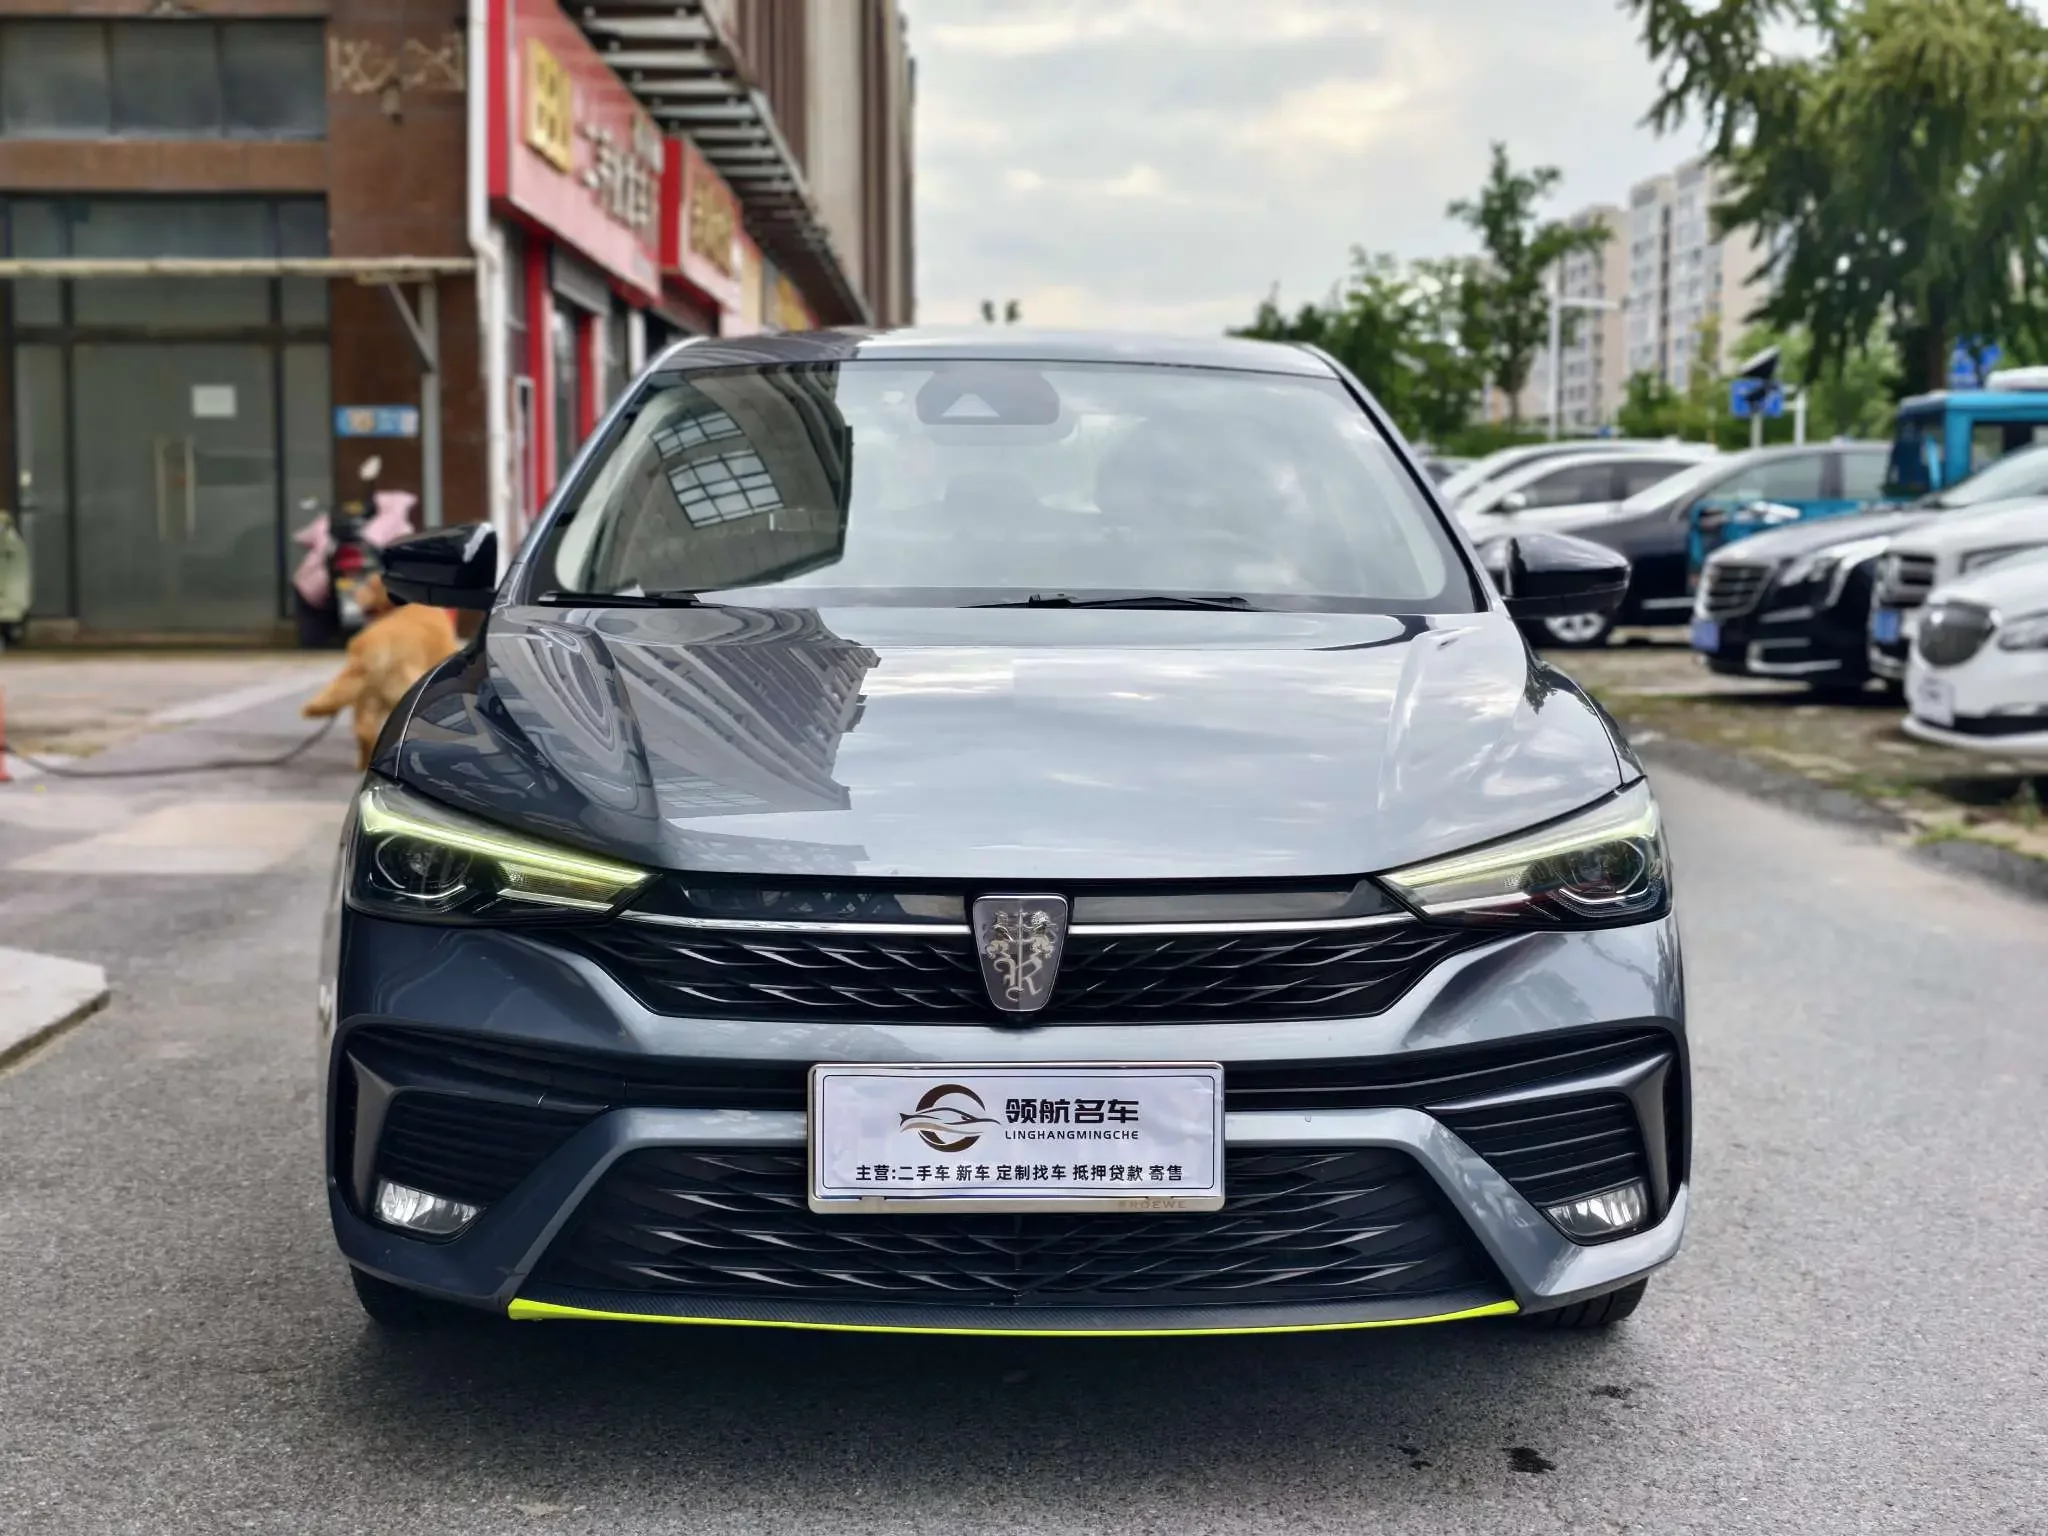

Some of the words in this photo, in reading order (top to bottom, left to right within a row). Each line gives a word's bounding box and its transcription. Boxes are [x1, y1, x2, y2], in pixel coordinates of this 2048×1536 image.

[1005, 1098, 1139, 1124] 领航名车
[1005, 1130, 1139, 1140] LINGHANGMINGCHE
[855, 1164, 950, 1181] 主营:二手车
[956, 1164, 990, 1181] 新车
[996, 1164, 1067, 1181] 定制找车
[1072, 1164, 1143, 1181] 抵押贷款
[1149, 1164, 1183, 1181] 寄售
